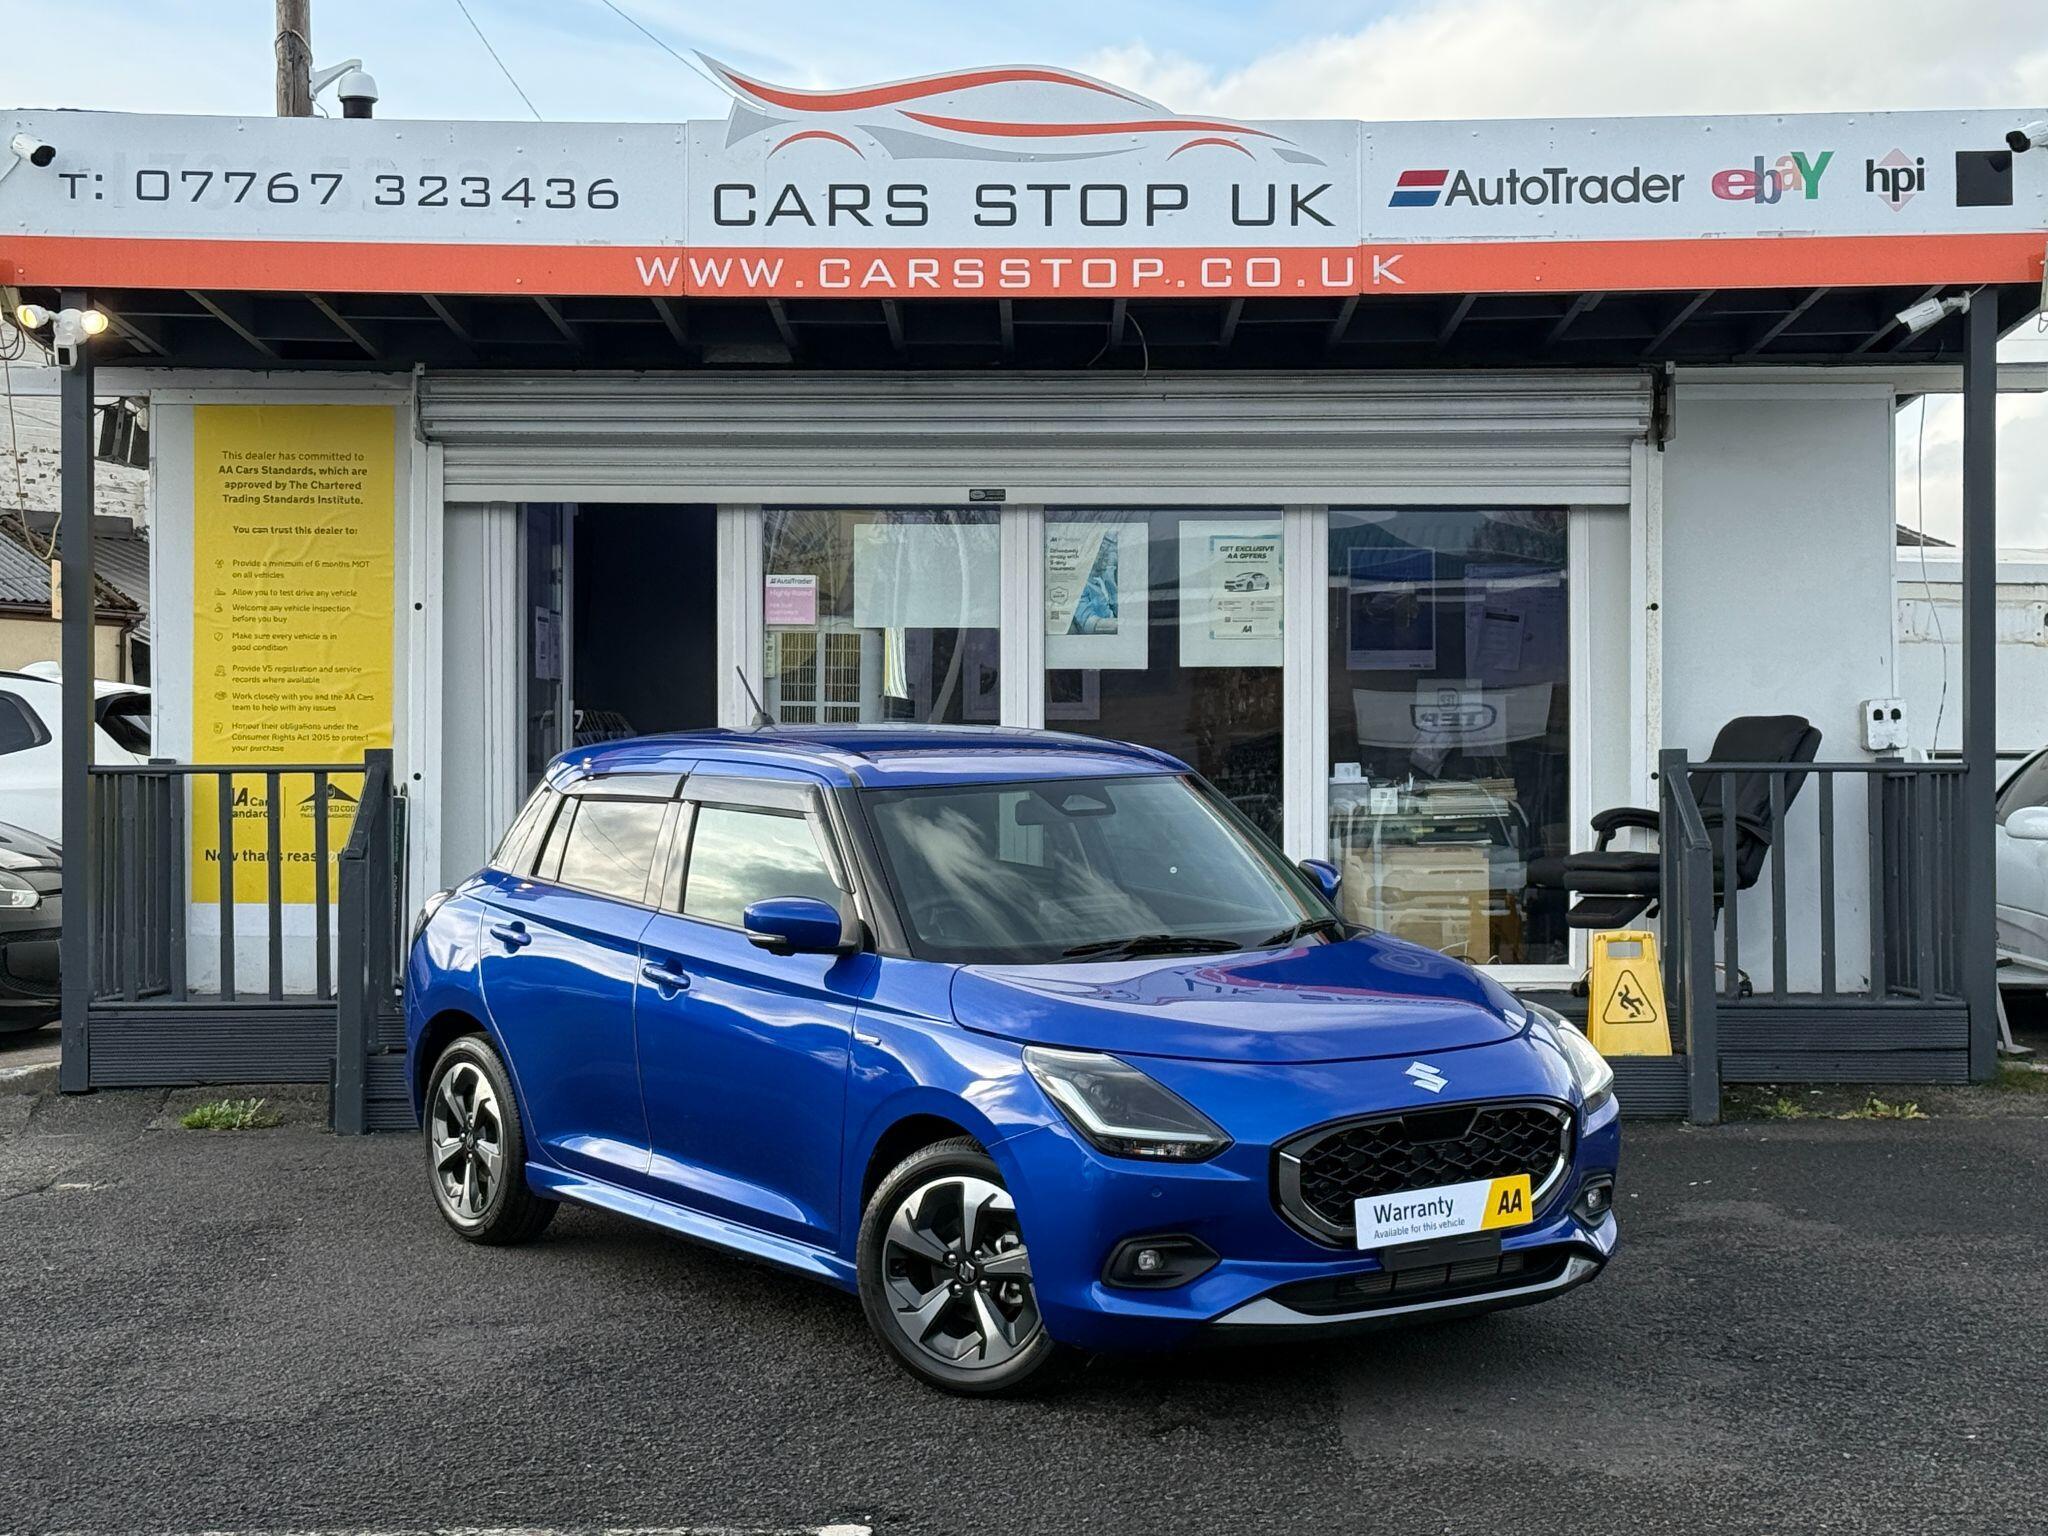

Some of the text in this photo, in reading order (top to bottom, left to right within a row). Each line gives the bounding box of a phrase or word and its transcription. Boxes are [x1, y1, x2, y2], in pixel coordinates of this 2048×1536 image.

[59, 170, 619, 210] T: 07767 323436
[1445, 167, 1685, 206] AutoTrader
[1865, 157, 1925, 203] hpi
[714, 183, 1335, 227] CARS STOP UK
[635, 253, 1405, 289] WWW.CARSSTOP.CO.UK
[222, 451, 364, 461] This dealer has committed to
[219, 466, 233, 474] AA
[236, 466, 259, 474] Cars
[261, 466, 317, 475] Standards,
[319, 467, 349, 476] which
[222, 494, 363, 505] Trading Standards Institute.
[224, 481, 362, 491] approved by The Chartered
[295, 526, 312, 534] this
[345, 527, 358, 535] to:
[1374, 1188, 1522, 1224] Warranty AA
[1374, 1218, 1465, 1239] Available for this vehicle
